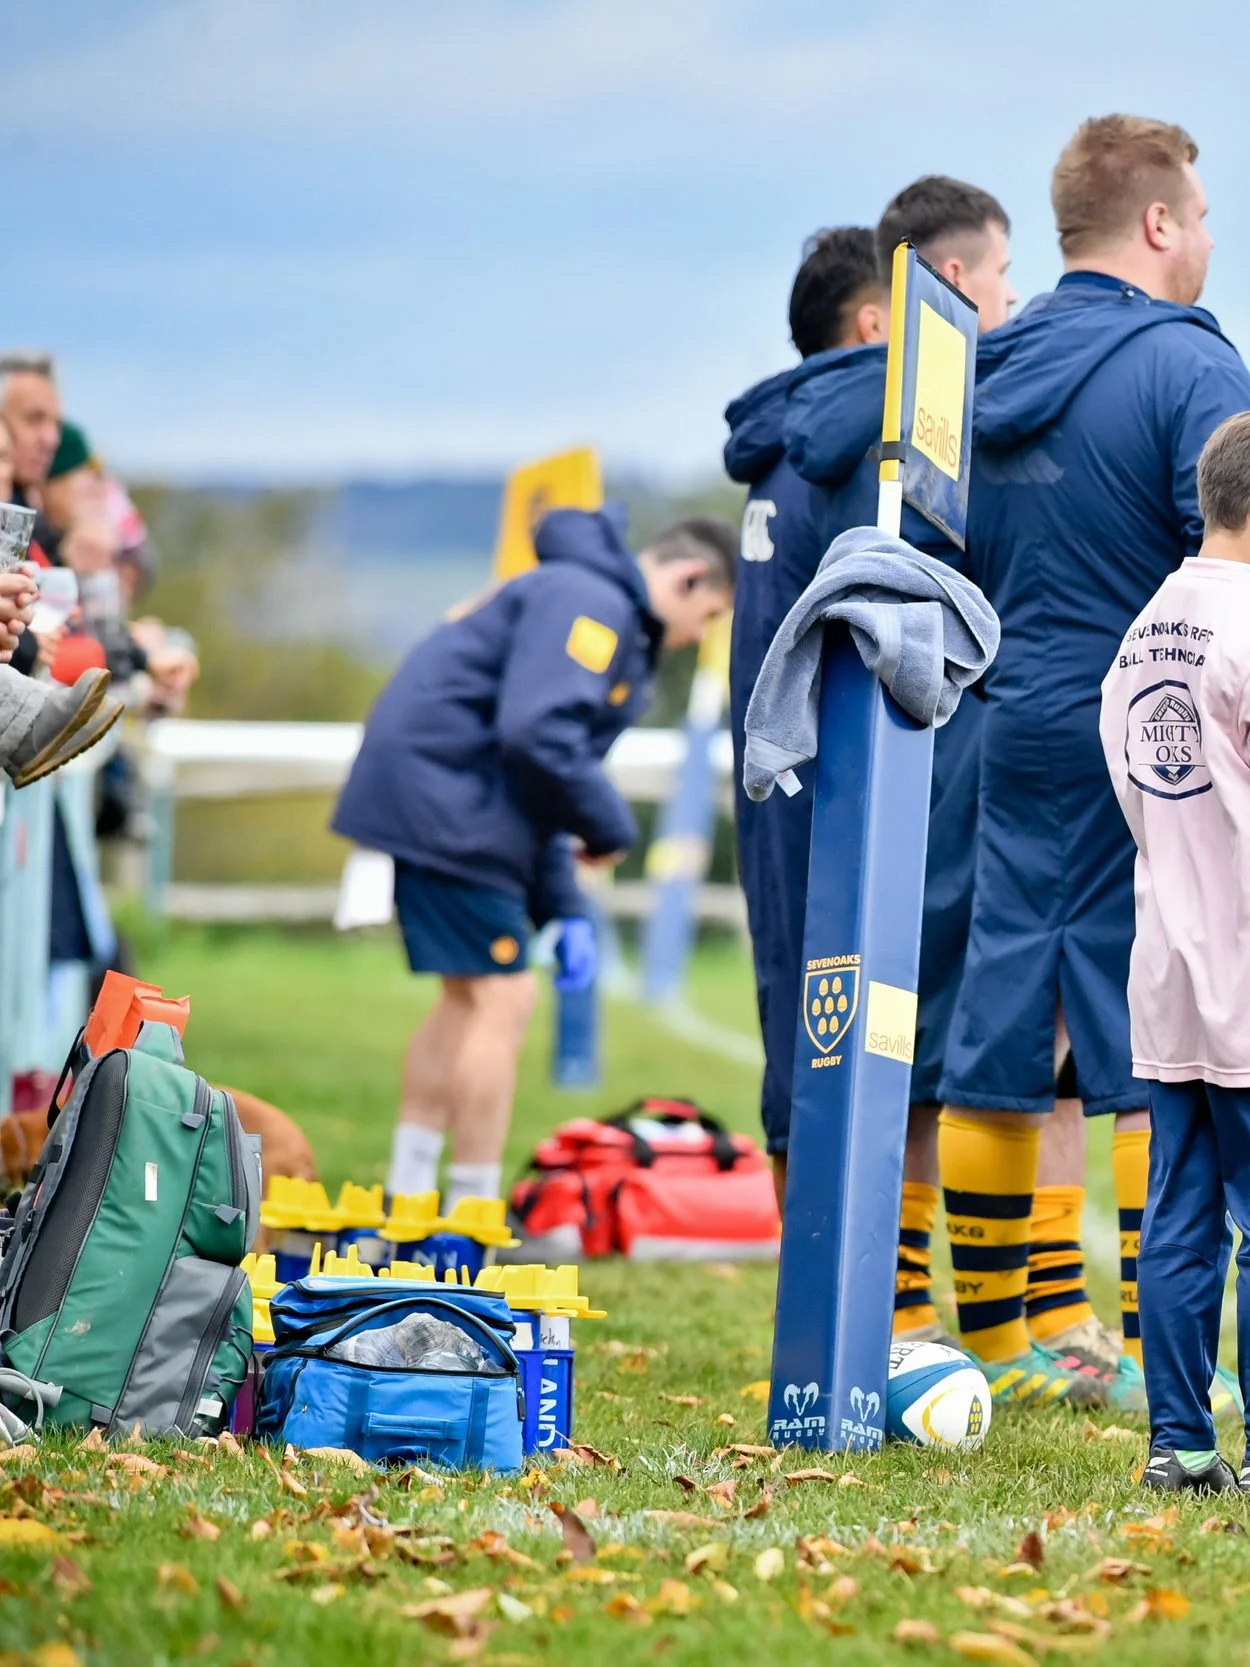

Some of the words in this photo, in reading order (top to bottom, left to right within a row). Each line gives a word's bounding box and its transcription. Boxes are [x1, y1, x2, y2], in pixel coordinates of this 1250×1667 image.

[916, 407, 957, 468] savills
[1190, 626, 1214, 643] RFC
[1120, 652, 1143, 669] BLL
[1156, 745, 1192, 763] OKS
[807, 954, 861, 970] SEVENOAKS
[869, 1032, 912, 1059] savills
[811, 1055, 842, 1069] RUGBY
[774, 1416, 826, 1430] RAM
[841, 1418, 883, 1440] RAM
[773, 1428, 825, 1440] RUGBY
